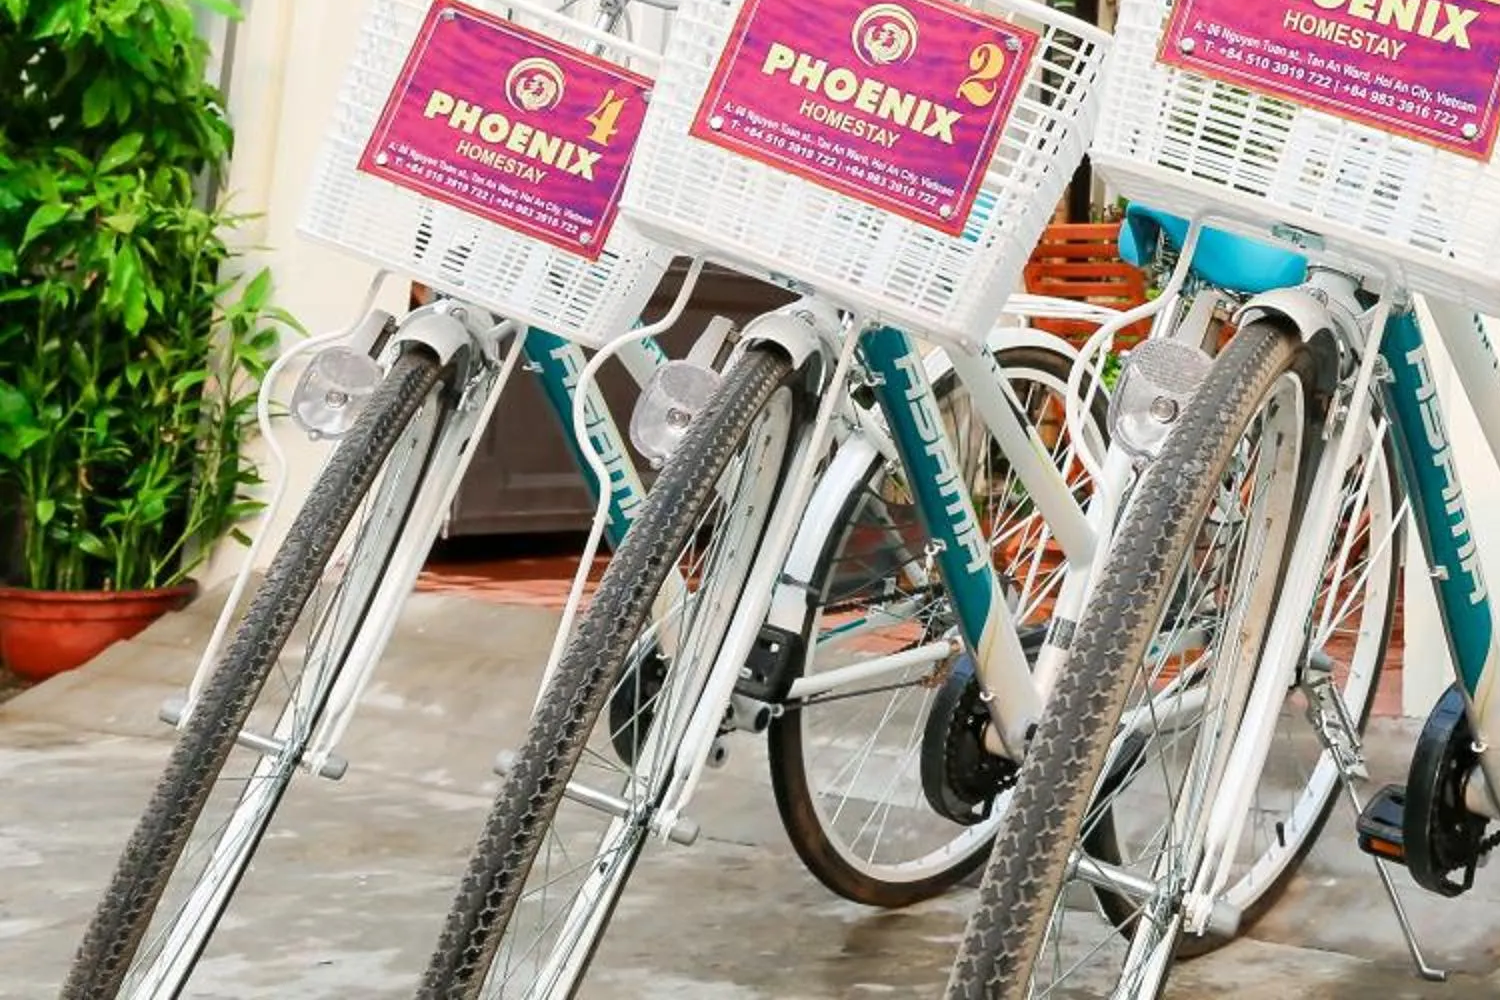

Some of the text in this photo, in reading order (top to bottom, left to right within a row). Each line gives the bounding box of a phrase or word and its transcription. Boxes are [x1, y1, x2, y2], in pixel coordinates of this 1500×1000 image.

[1283, 9, 1406, 60] HOMESTAY
[761, 43, 962, 144] PHOENIX
[956, 43, 1005, 107] 2
[423, 90, 602, 181] PHOENIX
[584, 89, 628, 147] 4
[799, 99, 900, 148] HOMESTAY
[456, 140, 547, 184] HOMESTAY
[893, 354, 993, 575] ASAMA
[1405, 345, 1488, 605] ASAMA
